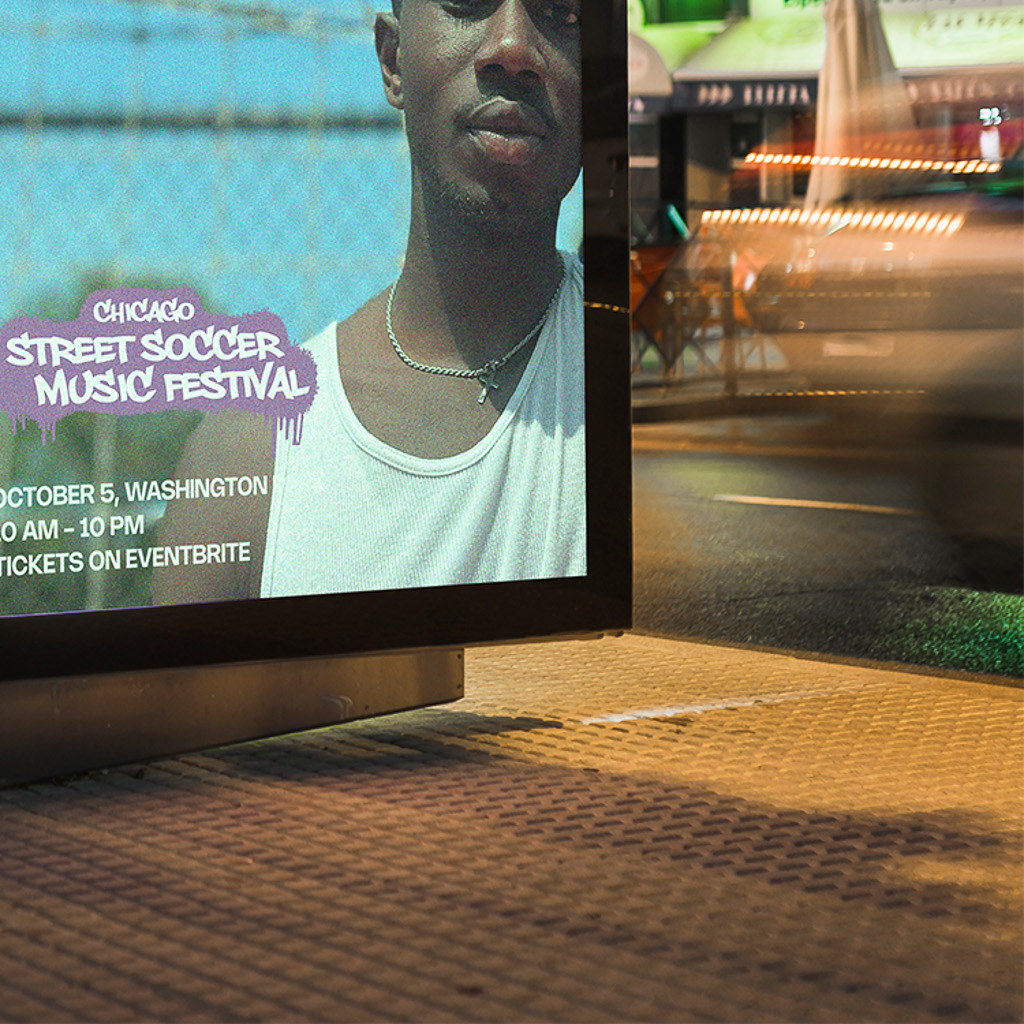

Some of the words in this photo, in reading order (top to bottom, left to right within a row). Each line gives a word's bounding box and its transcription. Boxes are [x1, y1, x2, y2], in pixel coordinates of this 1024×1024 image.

[93, 298, 195, 323] CHICAGO
[6, 333, 136, 367] STREET
[140, 325, 285, 362] SOCCER
[34, 366, 156, 406] MUSIC
[163, 361, 310, 402] FESTIVAL
[100, 482, 120, 506] 5,
[125, 475, 269, 502] WASHINGTON
[21, 519, 59, 542] AM
[80, 516, 106, 538] 10
[110, 514, 145, 536] PM
[88, 549, 121, 570] ON
[126, 542, 251, 568] EVENTBRITE
